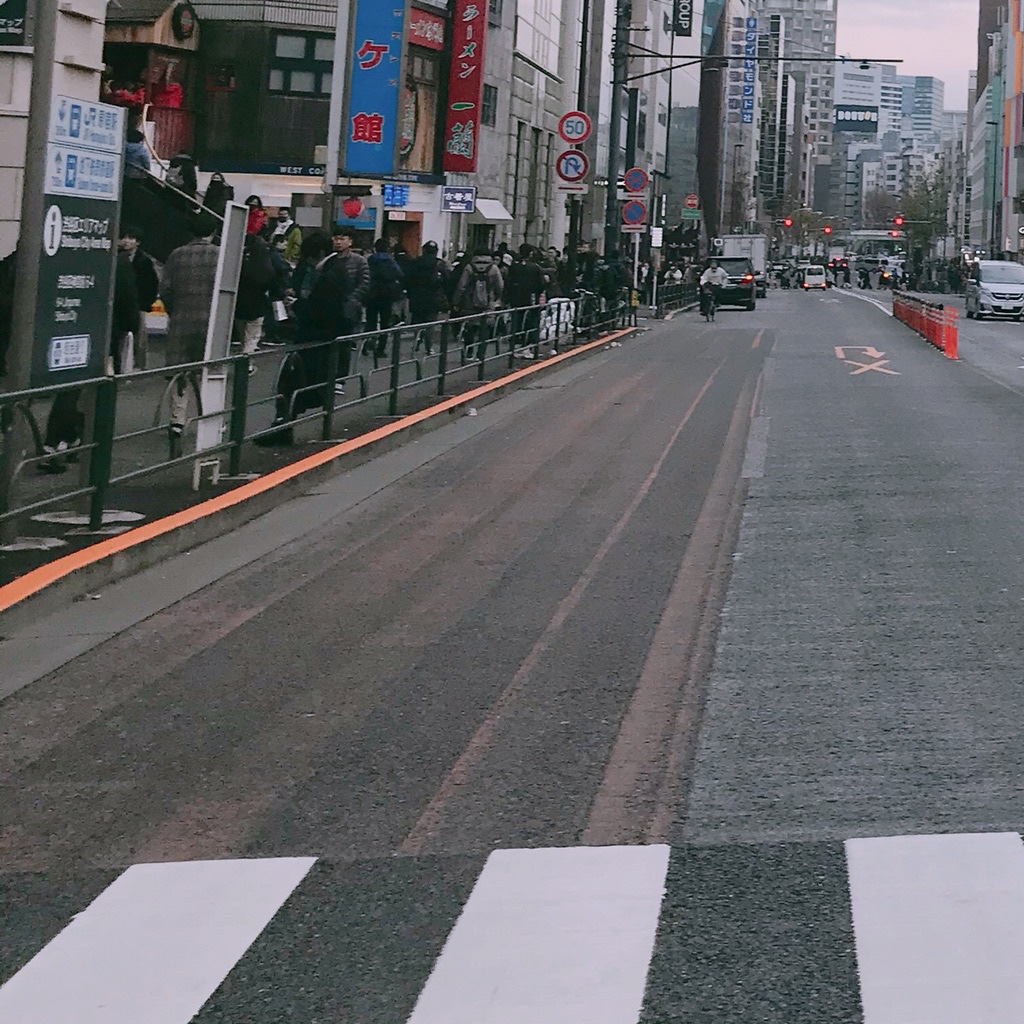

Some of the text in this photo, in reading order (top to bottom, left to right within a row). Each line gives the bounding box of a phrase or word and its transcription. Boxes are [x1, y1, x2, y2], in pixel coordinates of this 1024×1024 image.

[458, 4, 479, 79] ラーメン
[743, 31, 757, 123] ダイヤモンド社
[565, 120, 585, 135] 50
[280, 166, 303, 174] WEST
